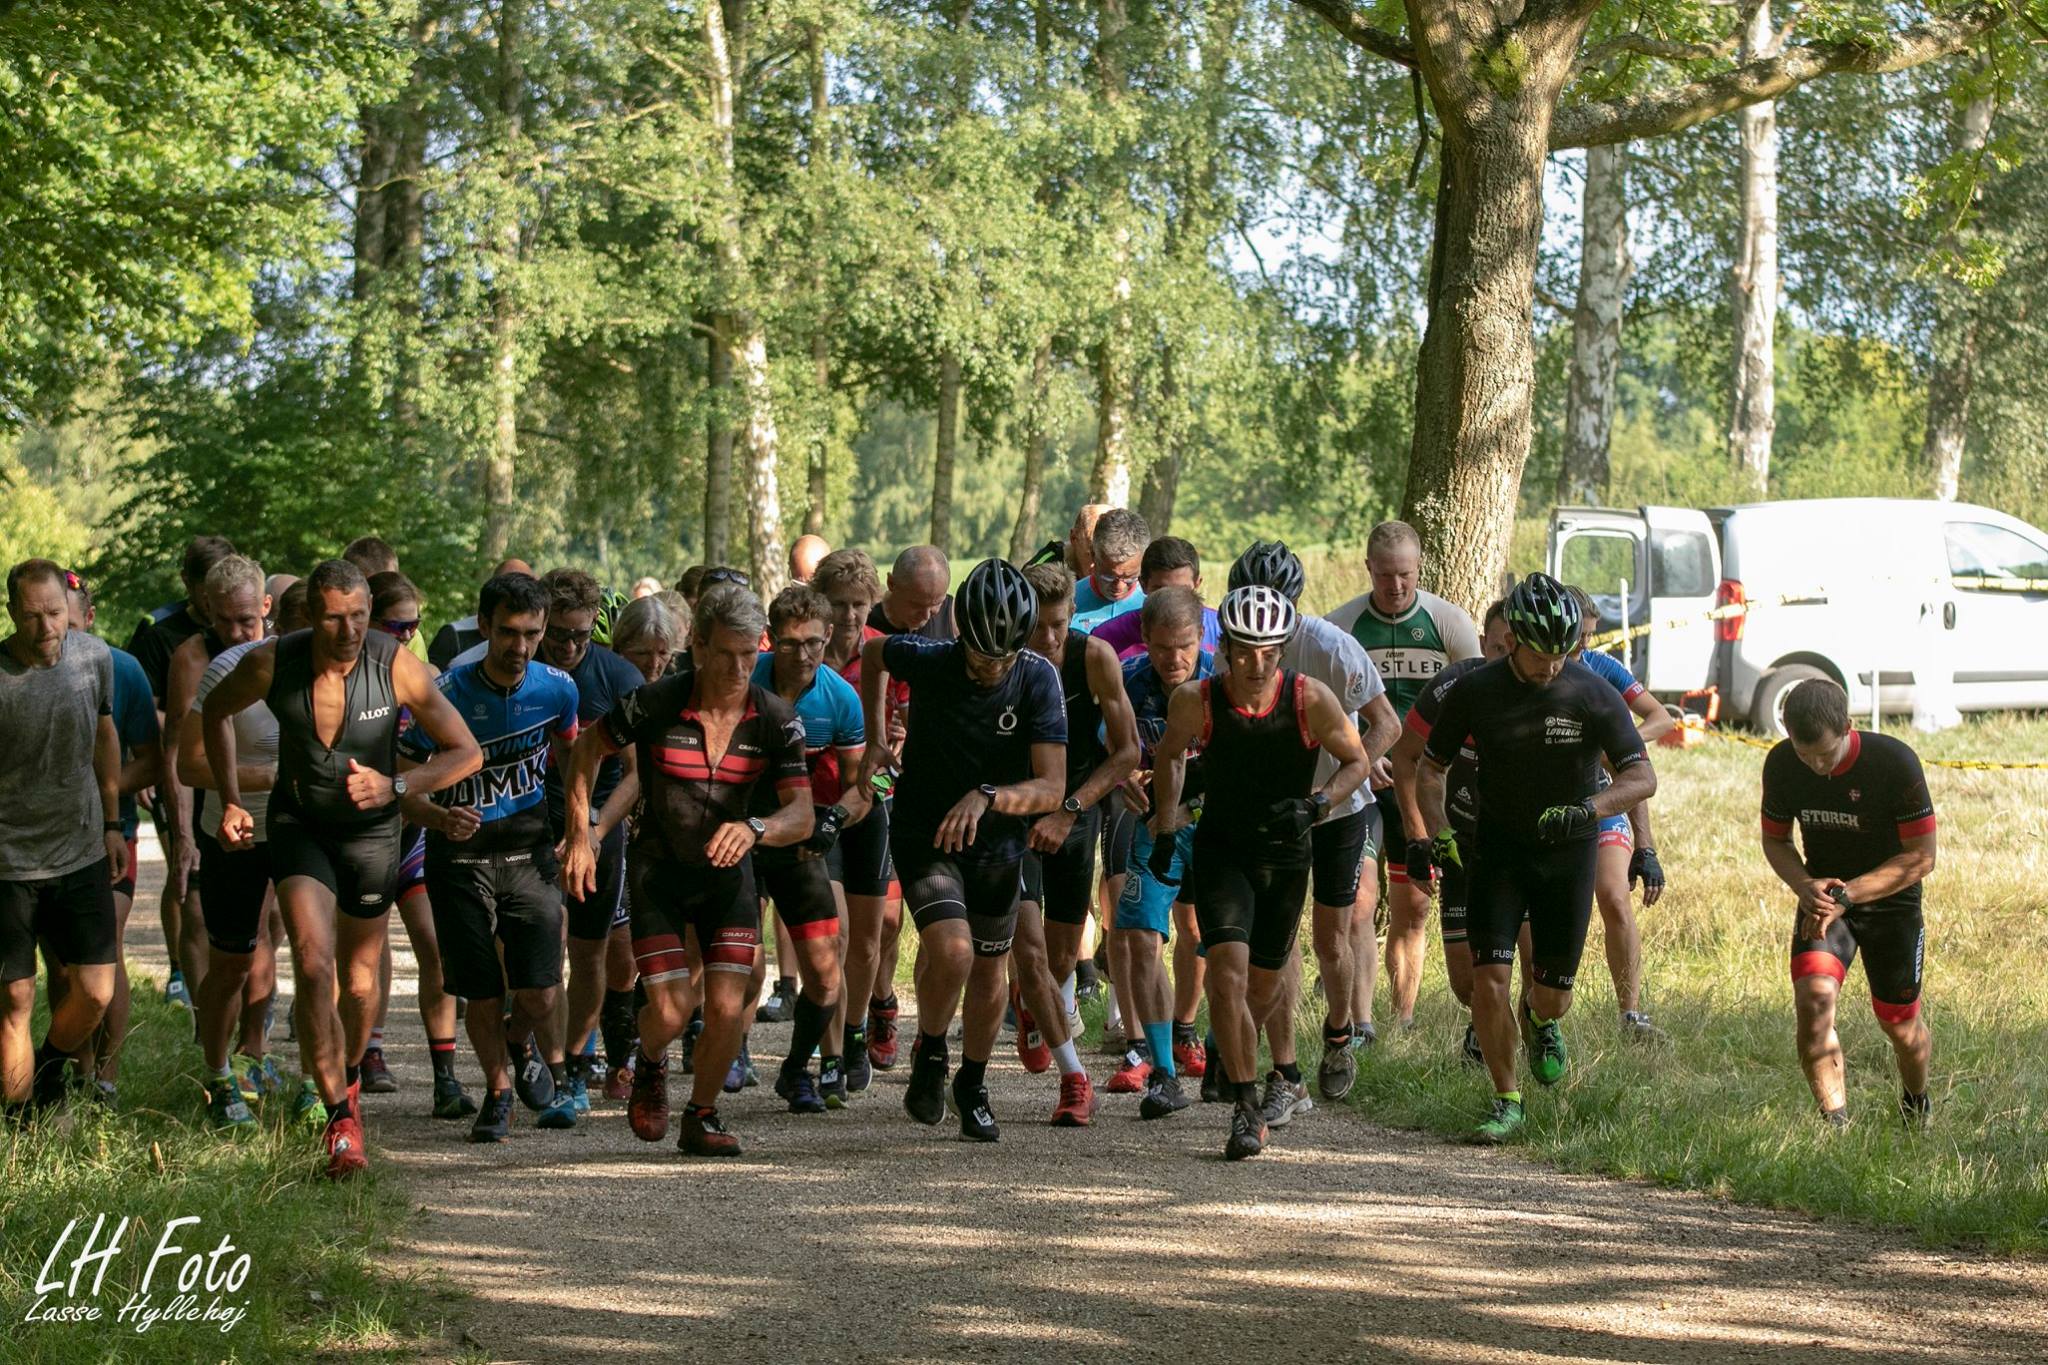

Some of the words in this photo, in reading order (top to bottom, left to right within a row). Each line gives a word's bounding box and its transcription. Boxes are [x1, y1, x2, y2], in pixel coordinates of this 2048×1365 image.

[1385, 651, 1405, 659] team
[1374, 660, 1443, 673] STLER
[358, 706, 390, 721] ALOT
